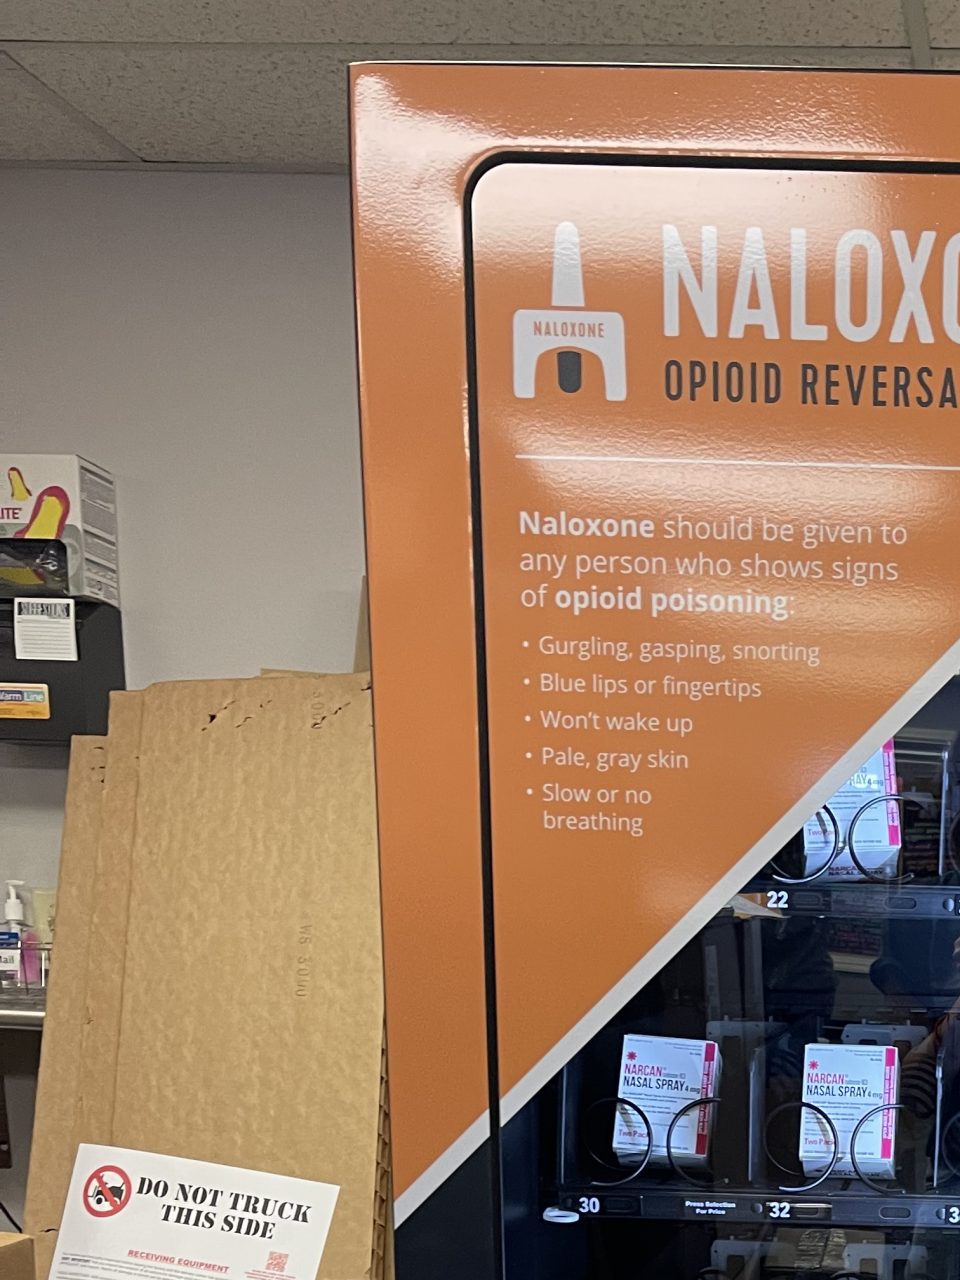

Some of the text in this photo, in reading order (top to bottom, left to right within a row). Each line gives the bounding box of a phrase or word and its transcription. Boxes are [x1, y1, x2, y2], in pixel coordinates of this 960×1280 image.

[533, 321, 605, 338] NALOXONE
[664, 360, 782, 404] OPIOID
[519, 511, 908, 549] Naloxone should be given to
[519, 552, 900, 587] any person who shows signs
[520, 584, 796, 622] of opioid poisoning:
[538, 635, 821, 666] Gurgling, gasping, snorting
[540, 673, 762, 702] Blue lips or fingertips
[540, 709, 694, 737] Won't wake up
[542, 747, 689, 773] Pale, gray skin
[542, 784, 652, 805] Slow or no
[543, 810, 644, 837] breathing
[766, 891, 789, 909] 22
[624, 1063, 662, 1077] NARCAN
[807, 1072, 845, 1085] NARCAN
[623, 1076, 685, 1092] NASAL SPRAY
[806, 1085, 836, 1097] NASAL
[838, 1086, 868, 1098] SPRAY
[137, 1177, 312, 1223] DO NOT TRUCK
[579, 1197, 600, 1213] 30
[769, 1202, 791, 1218] 32
[162, 1204, 276, 1240] THIS SIDE
[128, 1249, 229, 1273] RECEIVING EQUIPMENT
